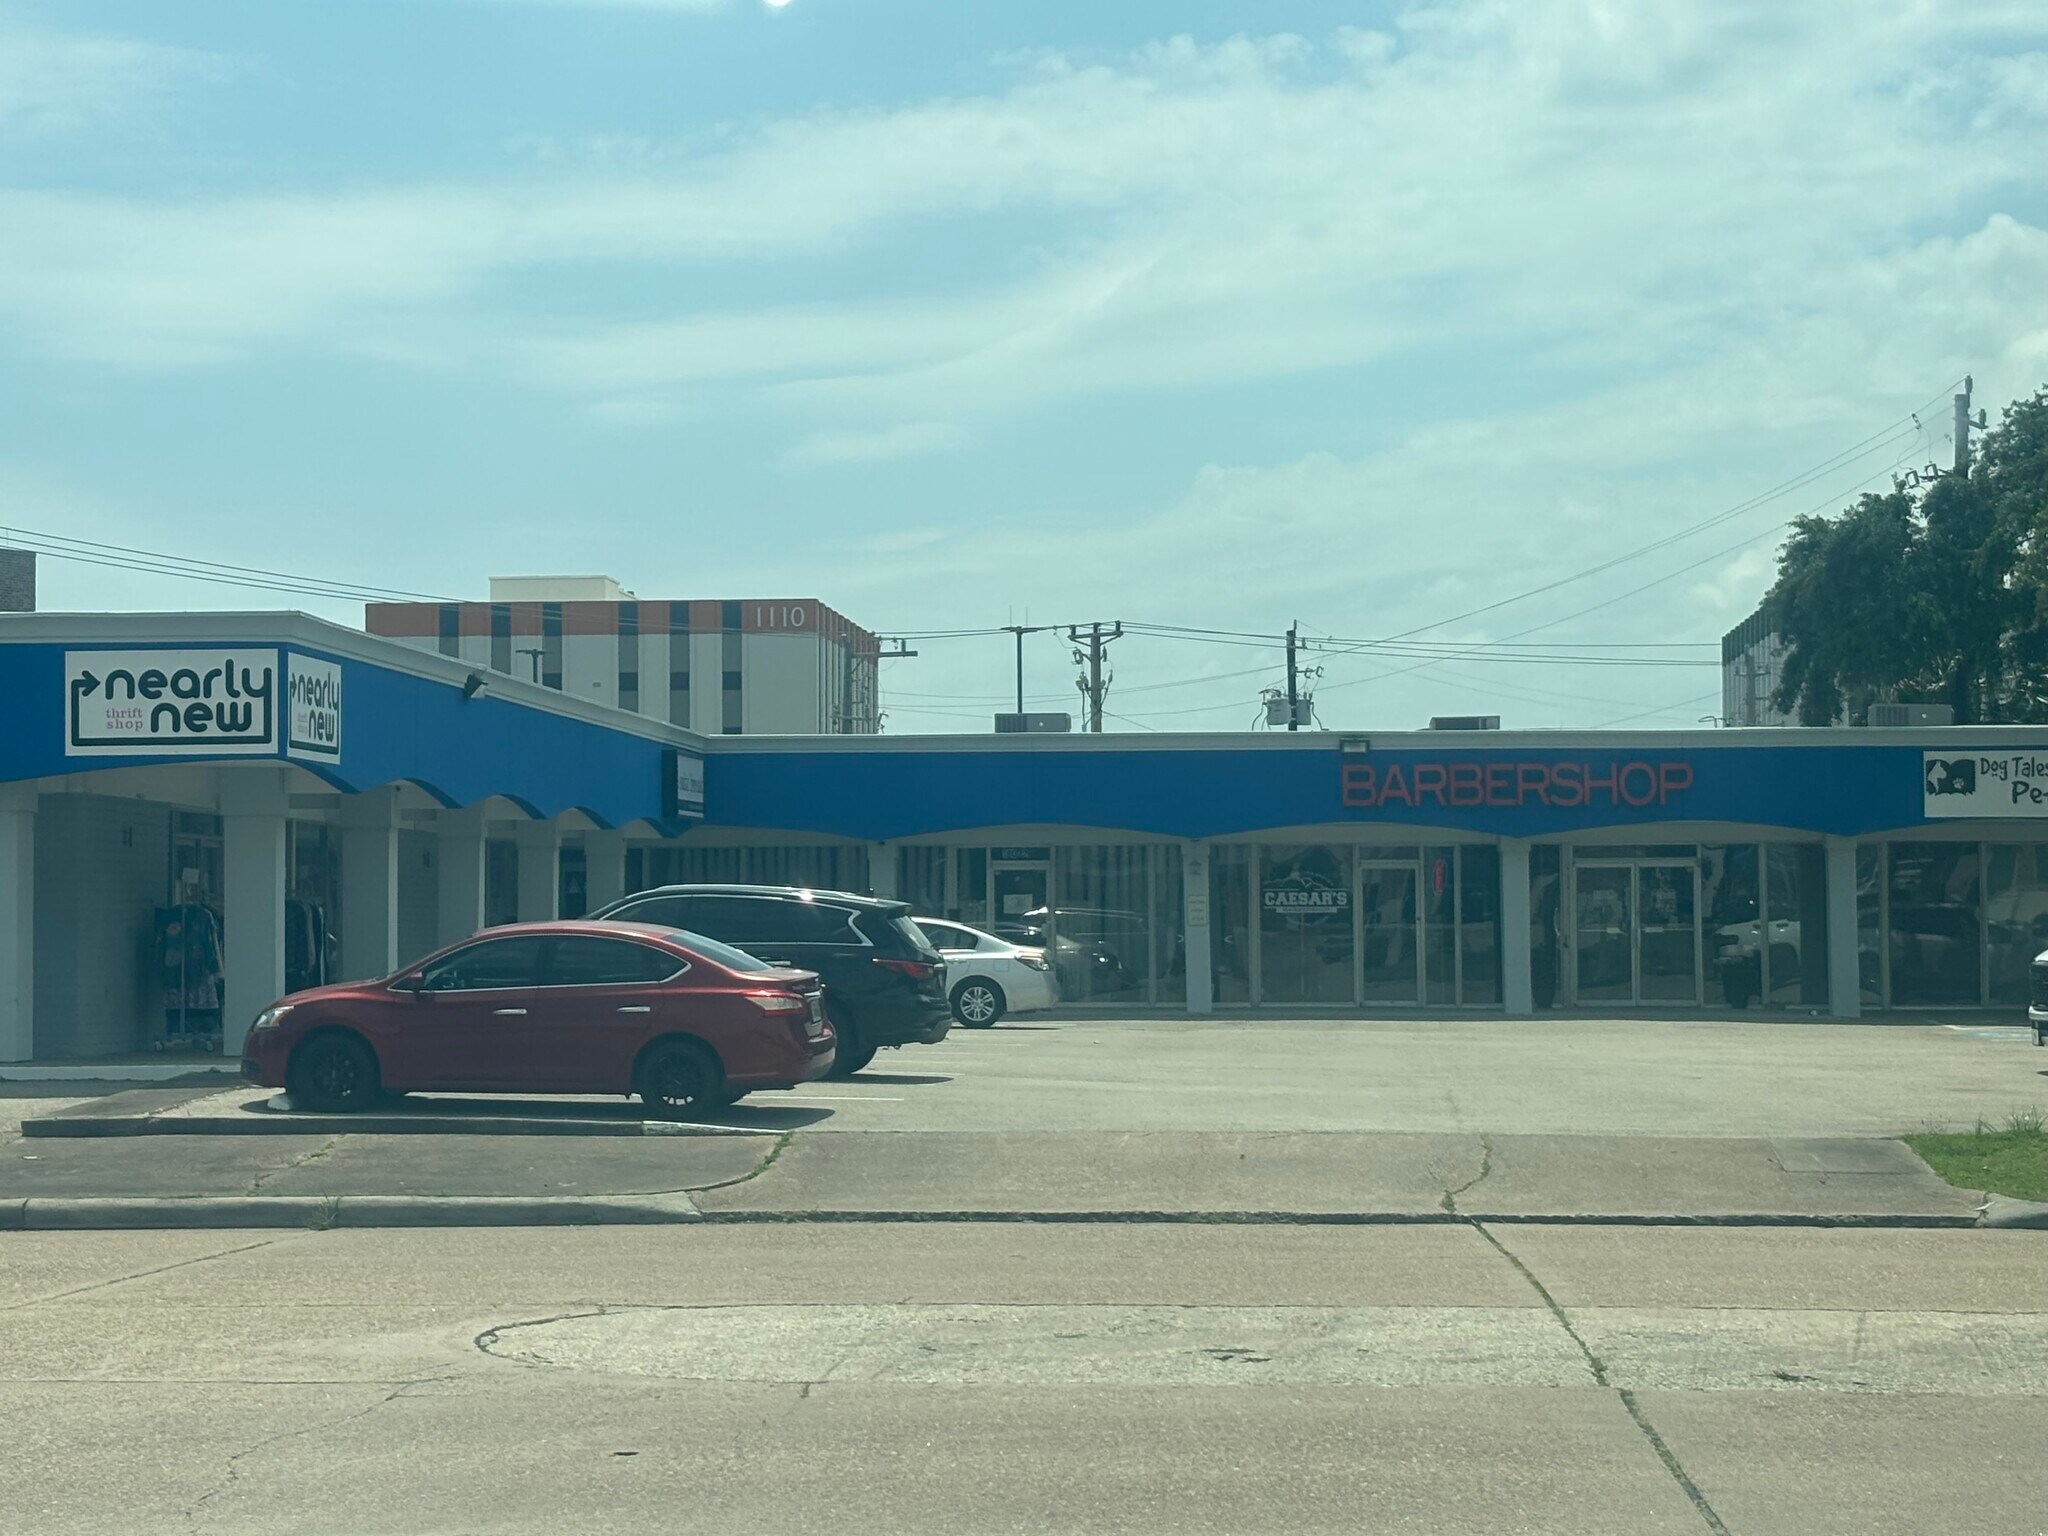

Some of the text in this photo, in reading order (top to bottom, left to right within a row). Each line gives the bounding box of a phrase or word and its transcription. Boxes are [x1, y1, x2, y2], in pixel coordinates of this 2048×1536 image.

[757, 606, 805, 628] 1110
[105, 658, 272, 700] nearly
[297, 671, 340, 711] nearly
[106, 707, 143, 719] thrift
[106, 719, 144, 732] shop
[150, 701, 252, 733] new
[308, 709, 335, 742] new
[1980, 757, 2008, 781] Dog
[1341, 762, 1694, 807] BARBERSHOP
[1264, 891, 1348, 906] CAESAR'S
